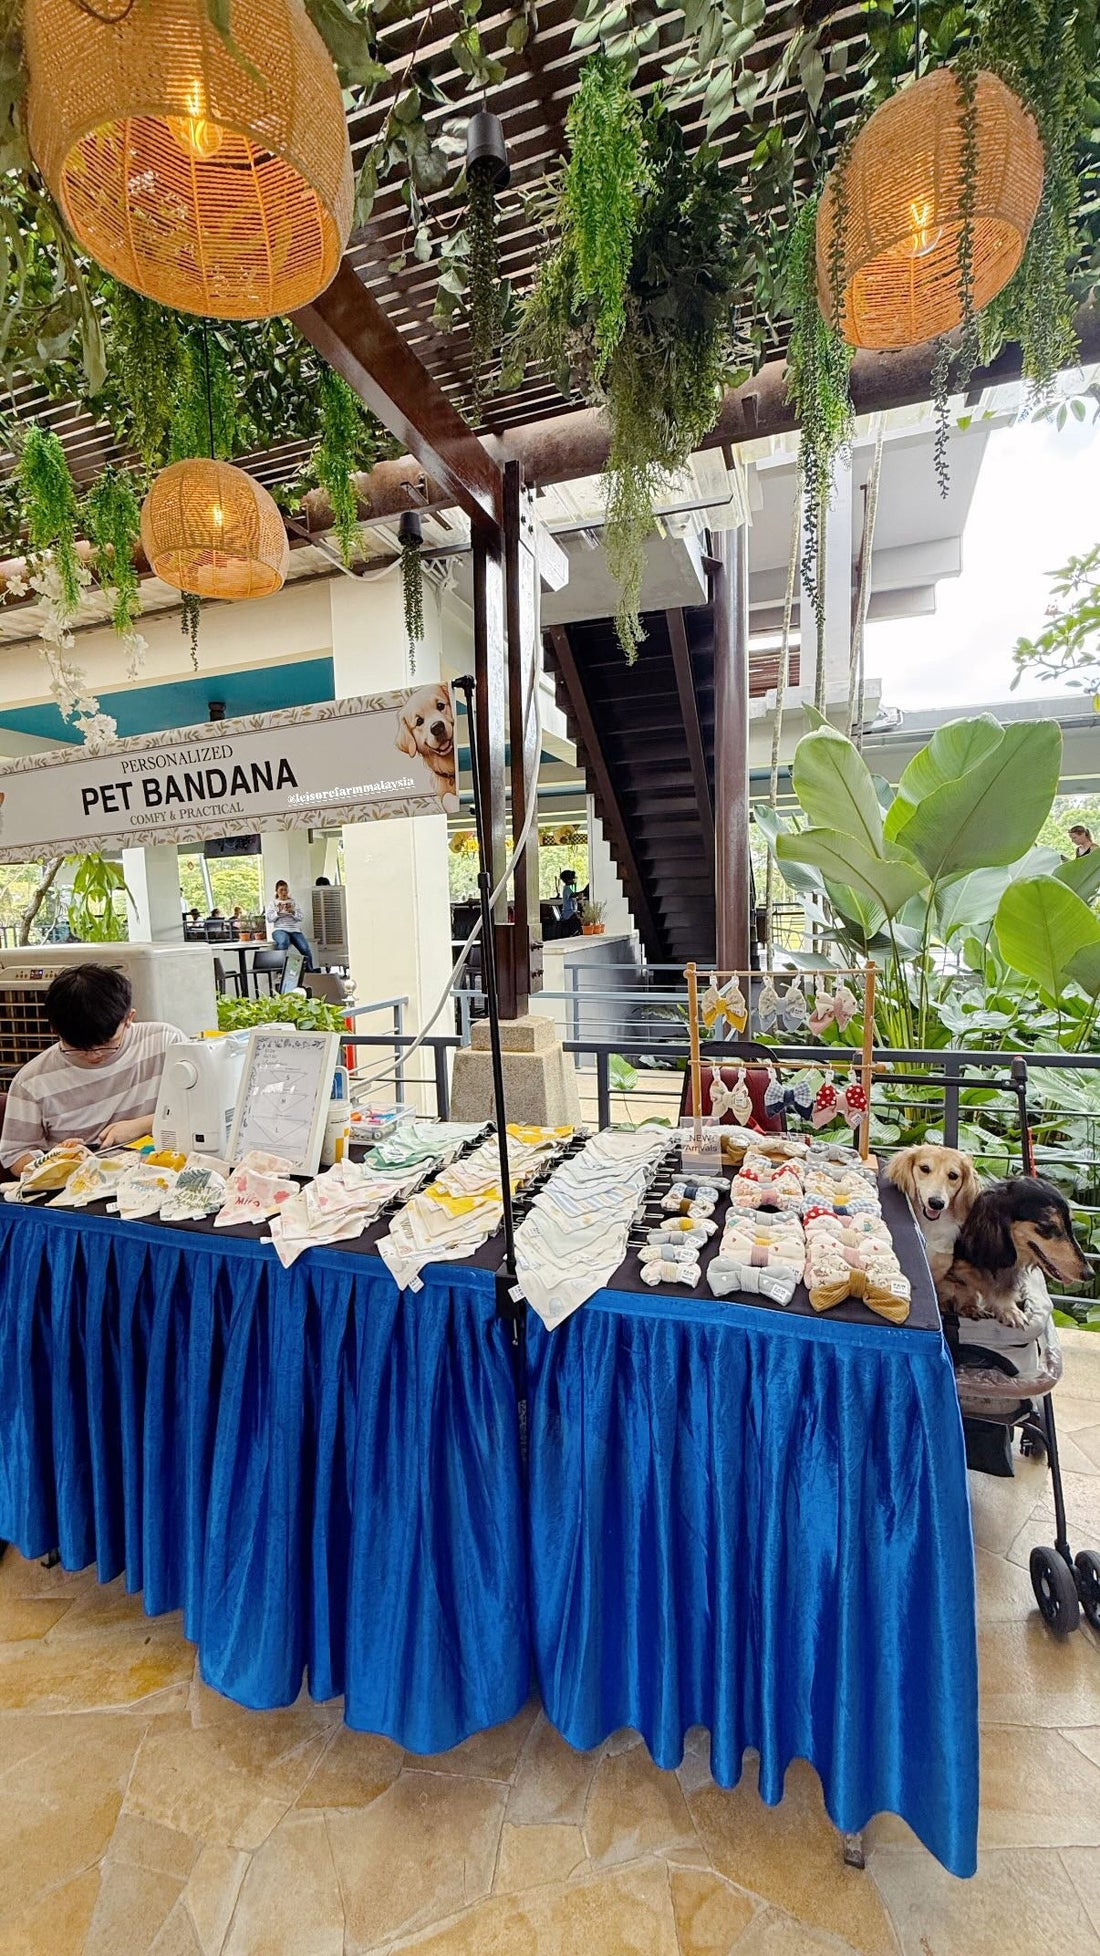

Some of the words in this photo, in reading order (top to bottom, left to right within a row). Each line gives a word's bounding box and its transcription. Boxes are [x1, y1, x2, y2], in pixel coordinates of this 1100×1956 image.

[121, 744, 233, 774] PERSONALIZED
[81, 782, 133, 816] PET
[142, 758, 298, 808] BANDANA
[130, 811, 167, 826] COMFY
[169, 812, 177, 821] &
[179, 802, 244, 820] PRACTICAL
[685, 1144, 718, 1152] Arrivals
[689, 1134, 711, 1142] NEW
